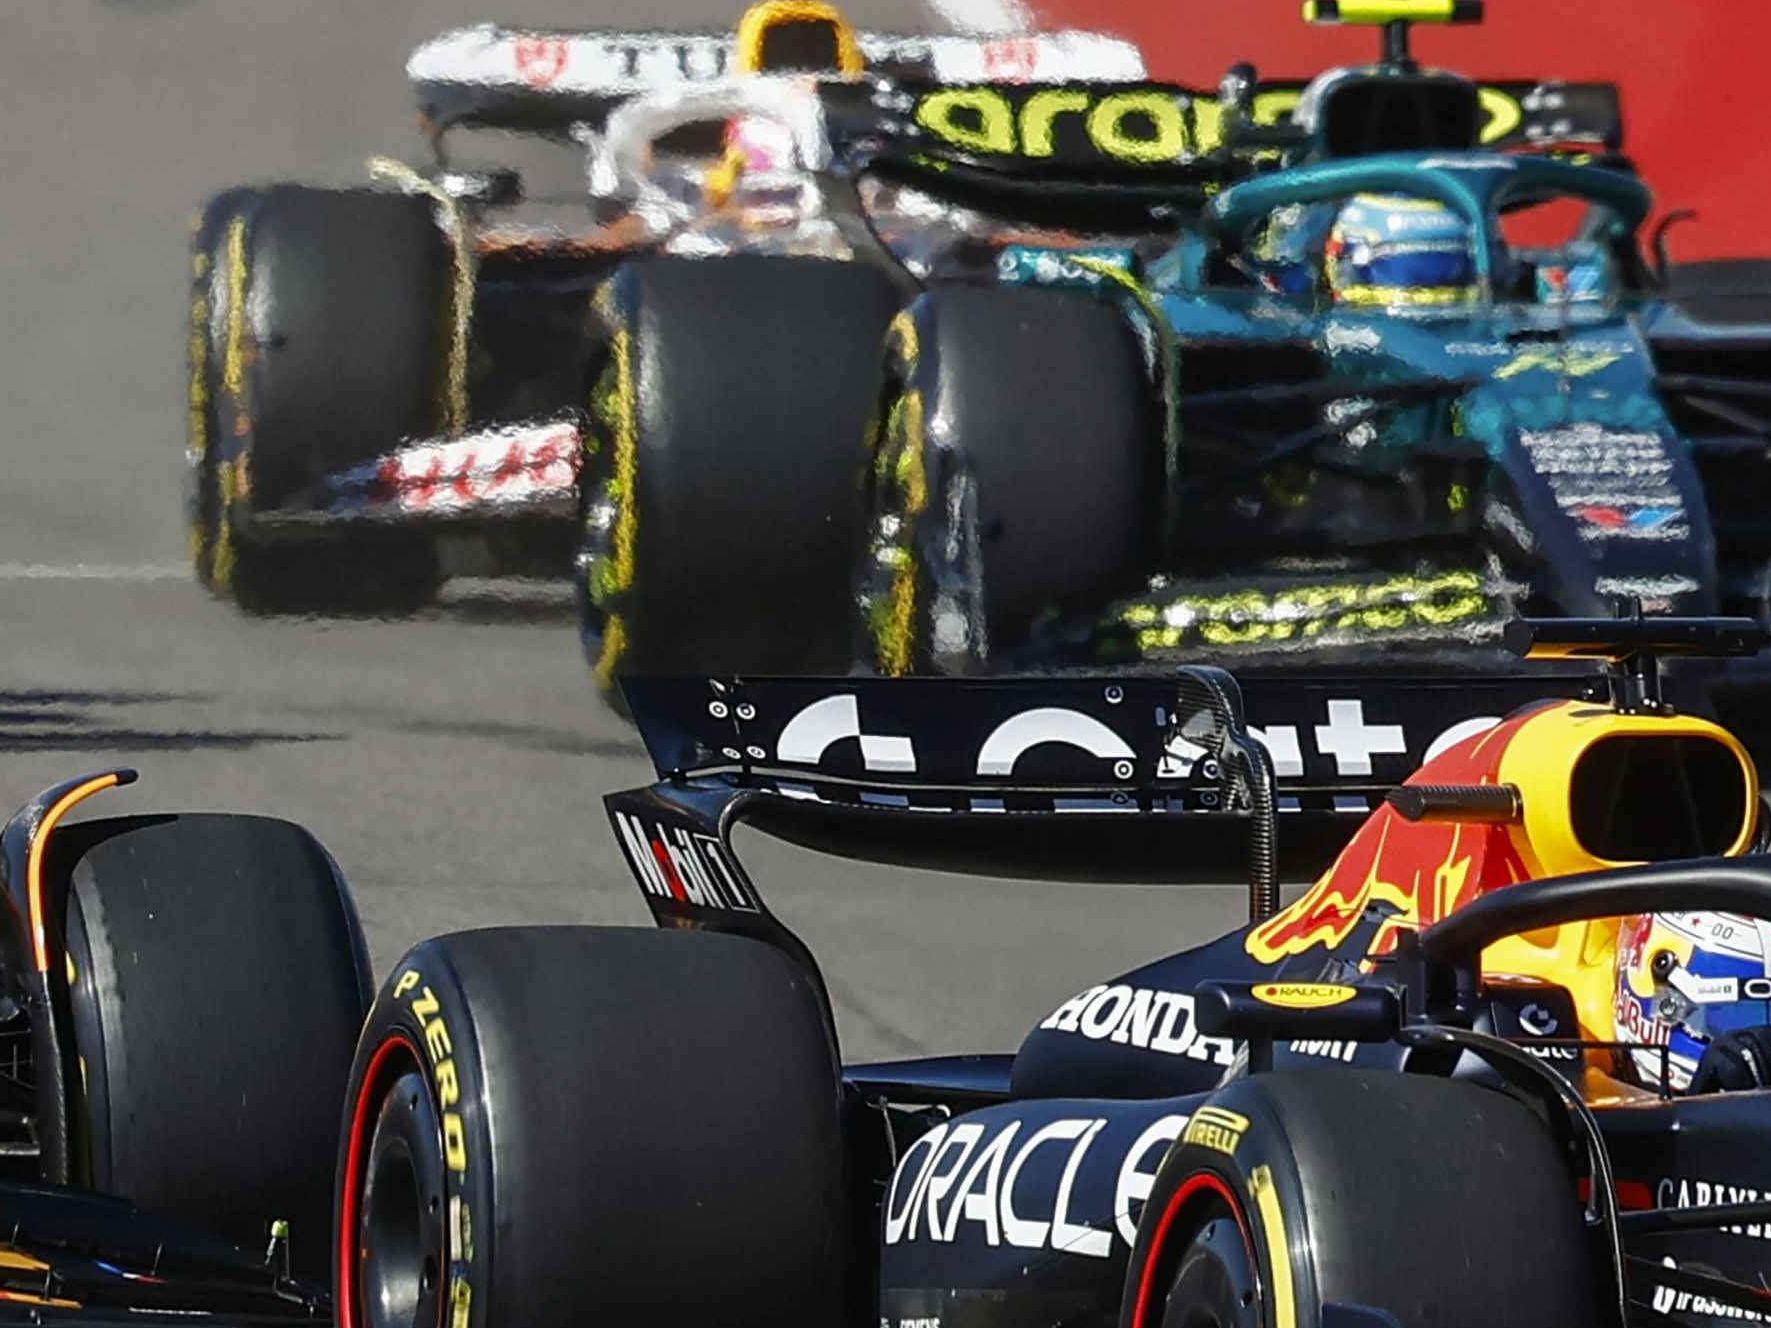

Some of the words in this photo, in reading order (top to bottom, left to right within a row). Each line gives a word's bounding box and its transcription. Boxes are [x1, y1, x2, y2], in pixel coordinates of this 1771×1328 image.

[614, 811, 726, 909] Mobil
[1277, 985, 1344, 999] RAUCH
[393, 970, 420, 1000] P
[410, 985, 467, 1174] ZERO
[1183, 1105, 1251, 1157] PIRELLI
